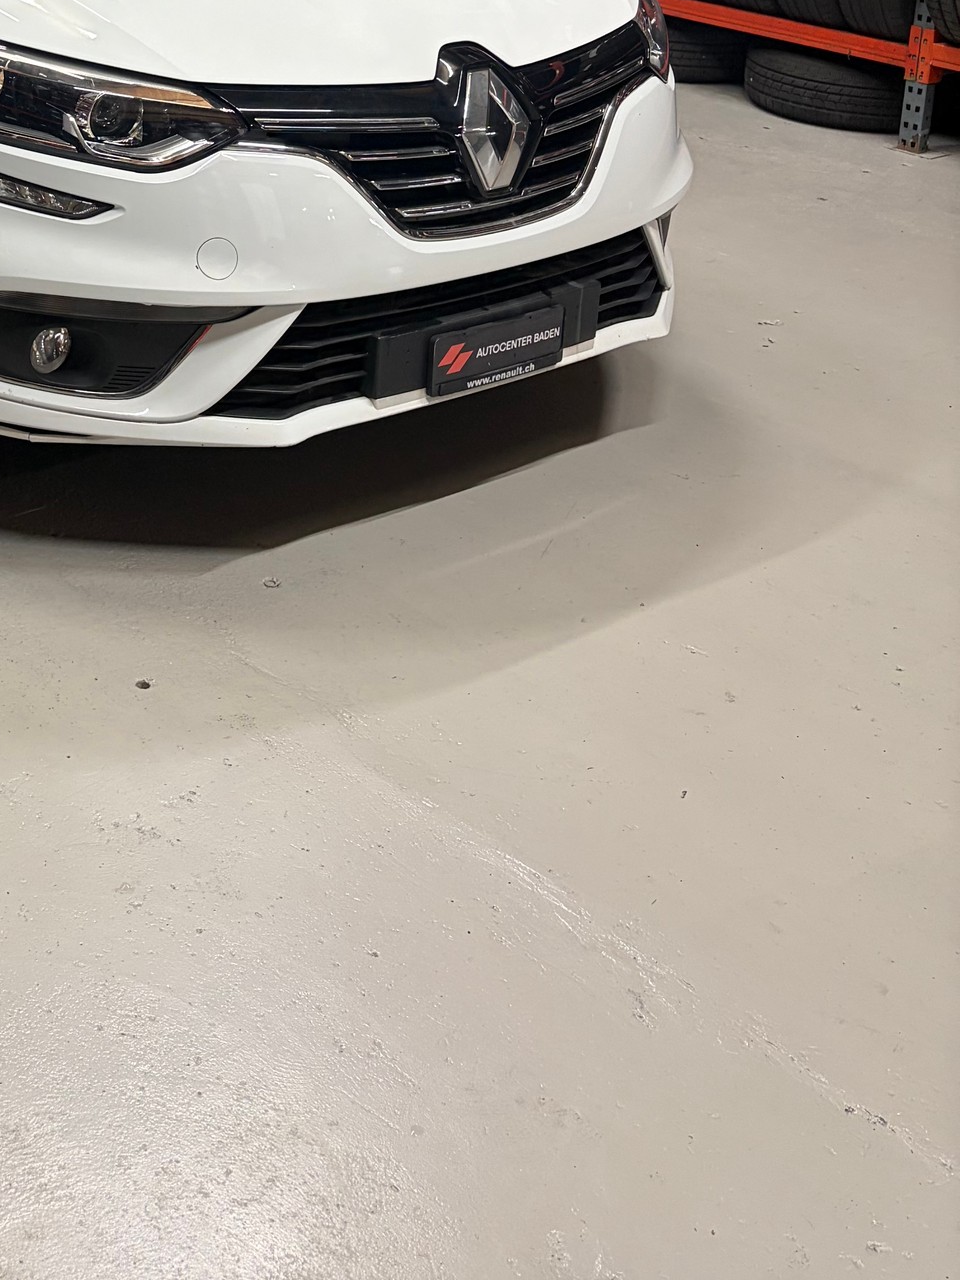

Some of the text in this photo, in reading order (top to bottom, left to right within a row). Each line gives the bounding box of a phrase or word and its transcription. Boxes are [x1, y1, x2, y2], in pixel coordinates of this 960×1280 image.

[476, 327, 560, 358] AUTOCENTER BADEN
[467, 362, 535, 388] www.renault.ch
